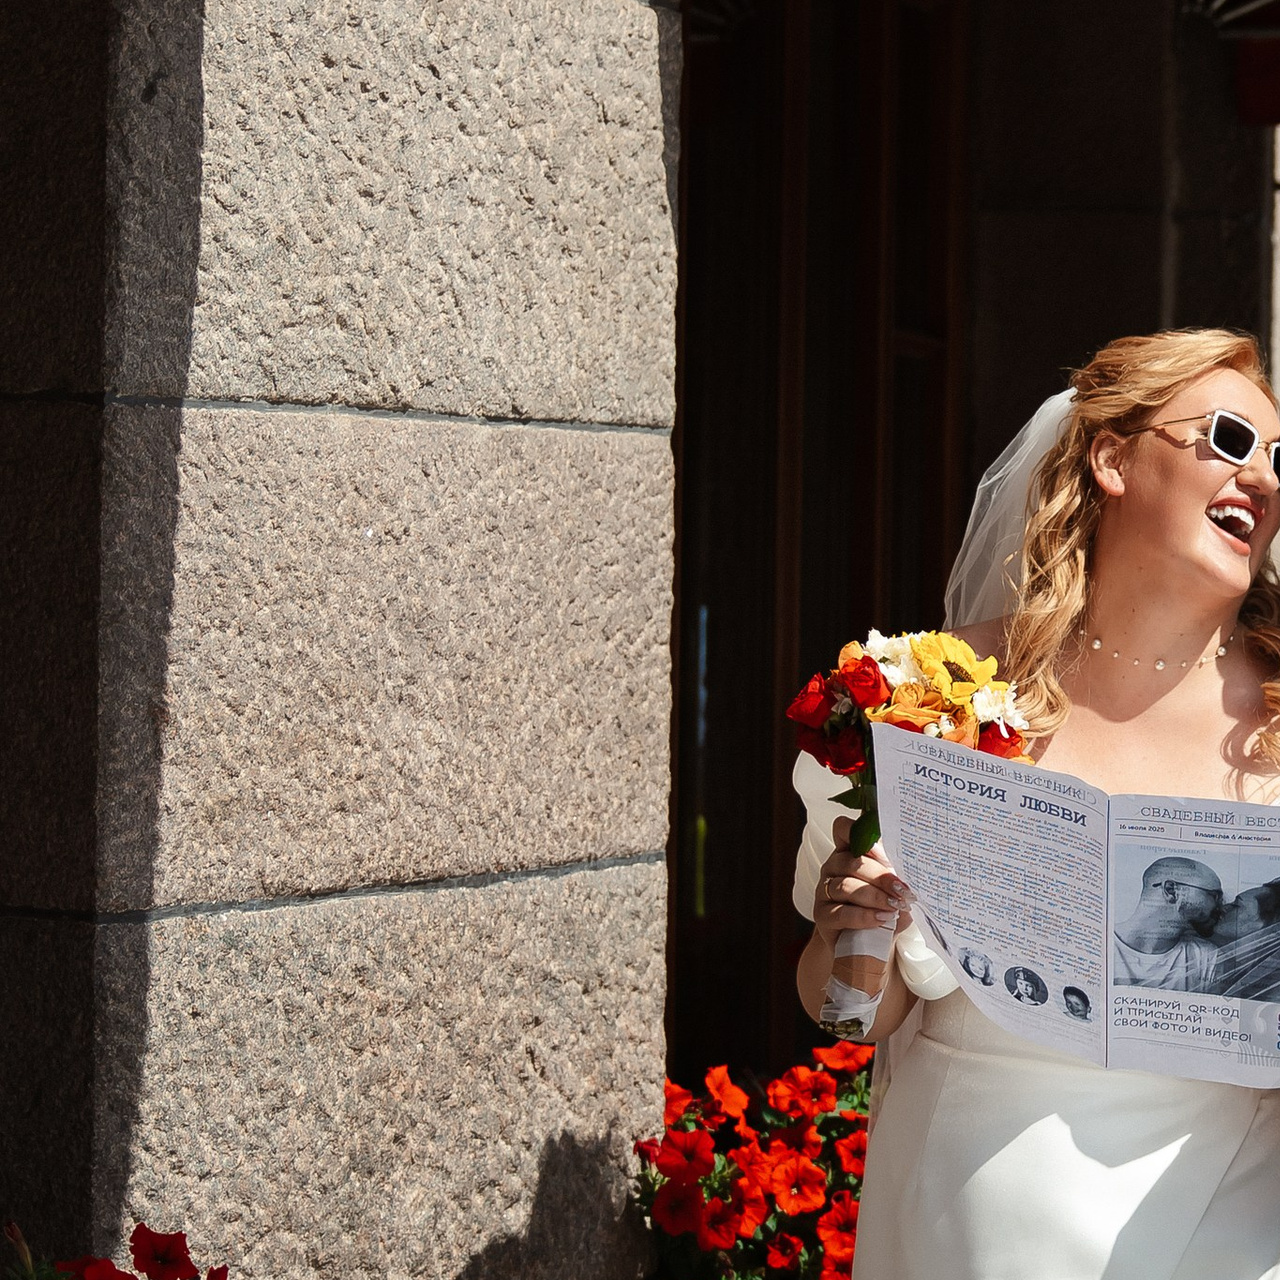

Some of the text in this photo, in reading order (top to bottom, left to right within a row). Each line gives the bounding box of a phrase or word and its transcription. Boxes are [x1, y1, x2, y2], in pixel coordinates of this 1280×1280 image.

[917, 742, 1083, 801] СВАДЕБНЫЙ ВЕСТНИК
[913, 763, 1008, 802] ИСТОРИЯ
[1019, 793, 1088, 827] ЛЮБВИ
[1140, 806, 1236, 826] СВАДЕБНЫЙ
[1114, 996, 1240, 1019] СКАНИРУЙ QR-КОД
[1114, 1007, 1202, 1024] И ПРИСЫЛАЙ
[1114, 1017, 1253, 1042] СВОИ ФОТО И ВИДЕО!
